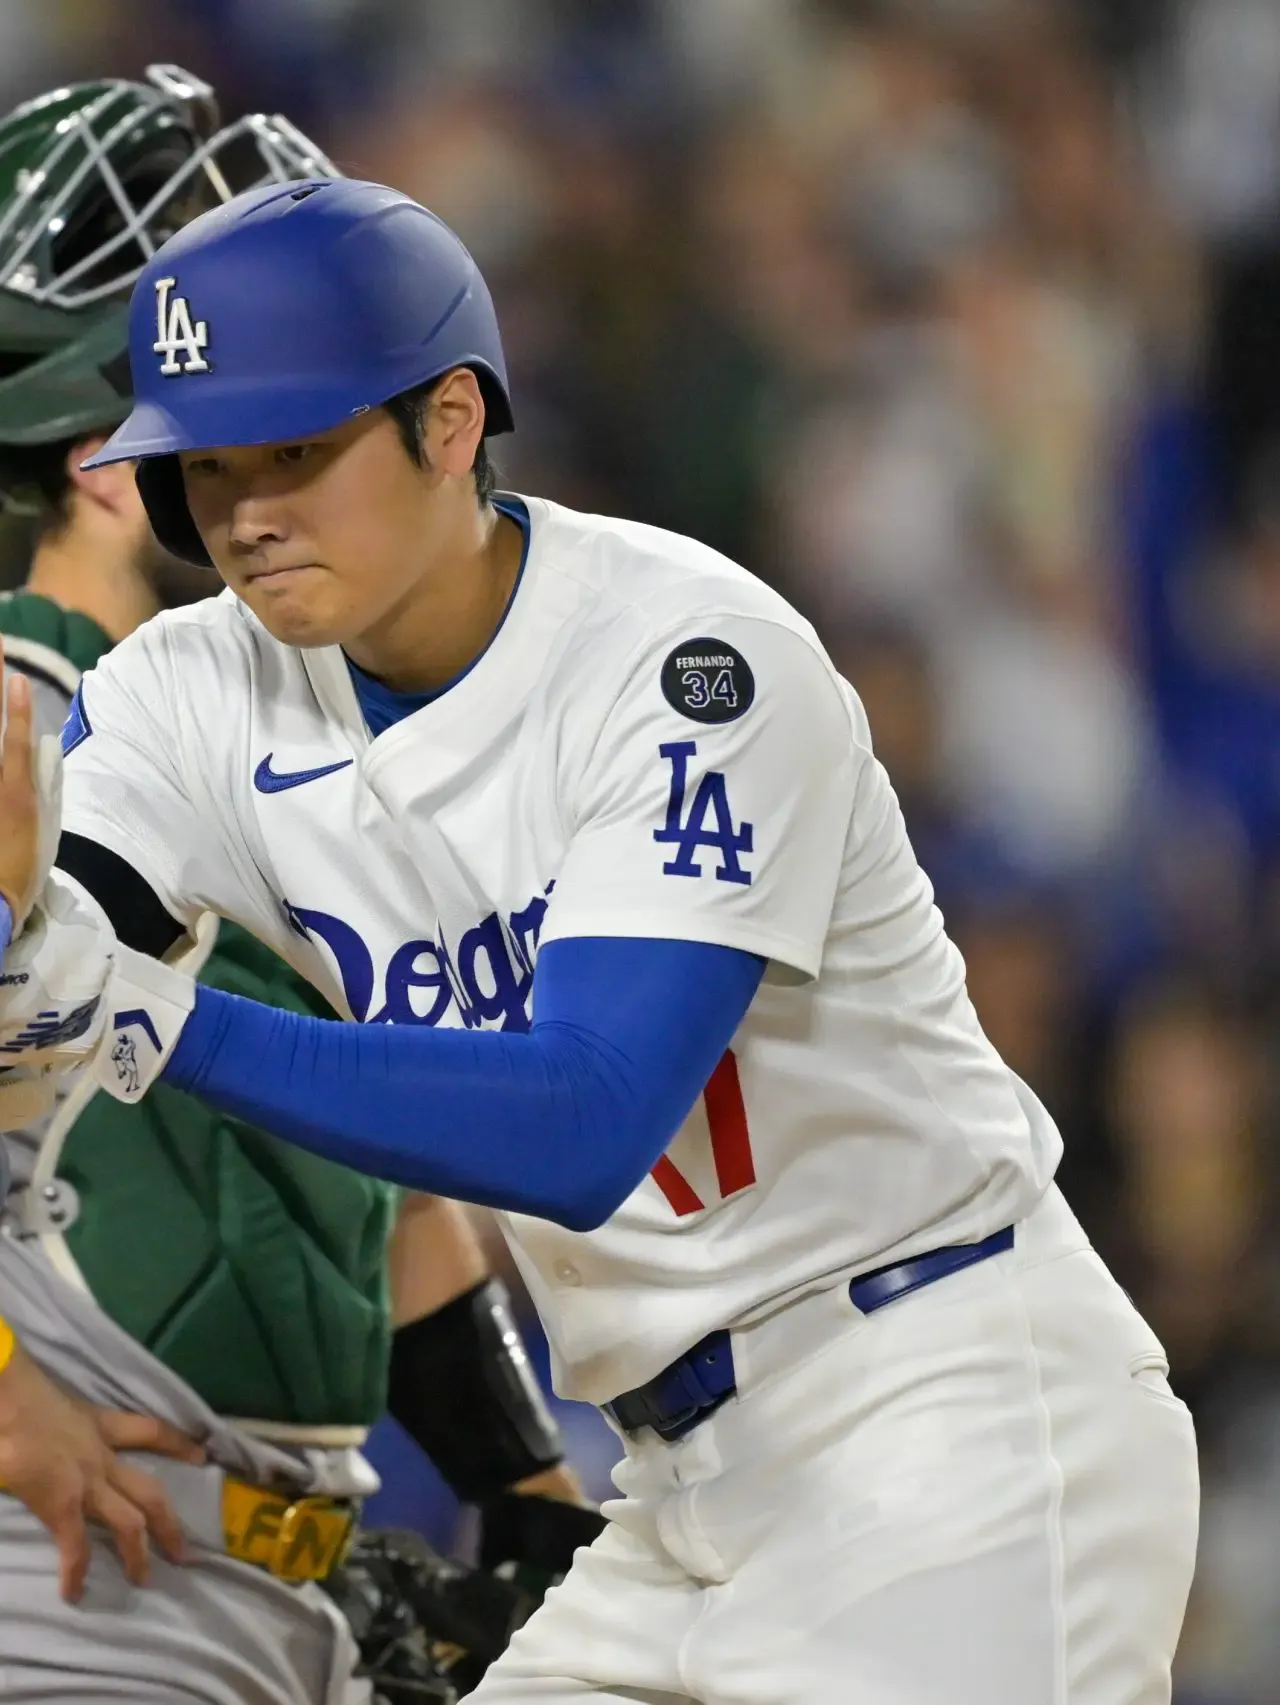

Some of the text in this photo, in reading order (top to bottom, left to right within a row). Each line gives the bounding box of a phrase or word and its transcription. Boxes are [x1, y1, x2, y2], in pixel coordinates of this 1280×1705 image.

[153, 277, 208, 374] LA
[675, 655, 735, 669] FERNANDO
[681, 669, 739, 709] 34
[653, 740, 754, 886] LA
